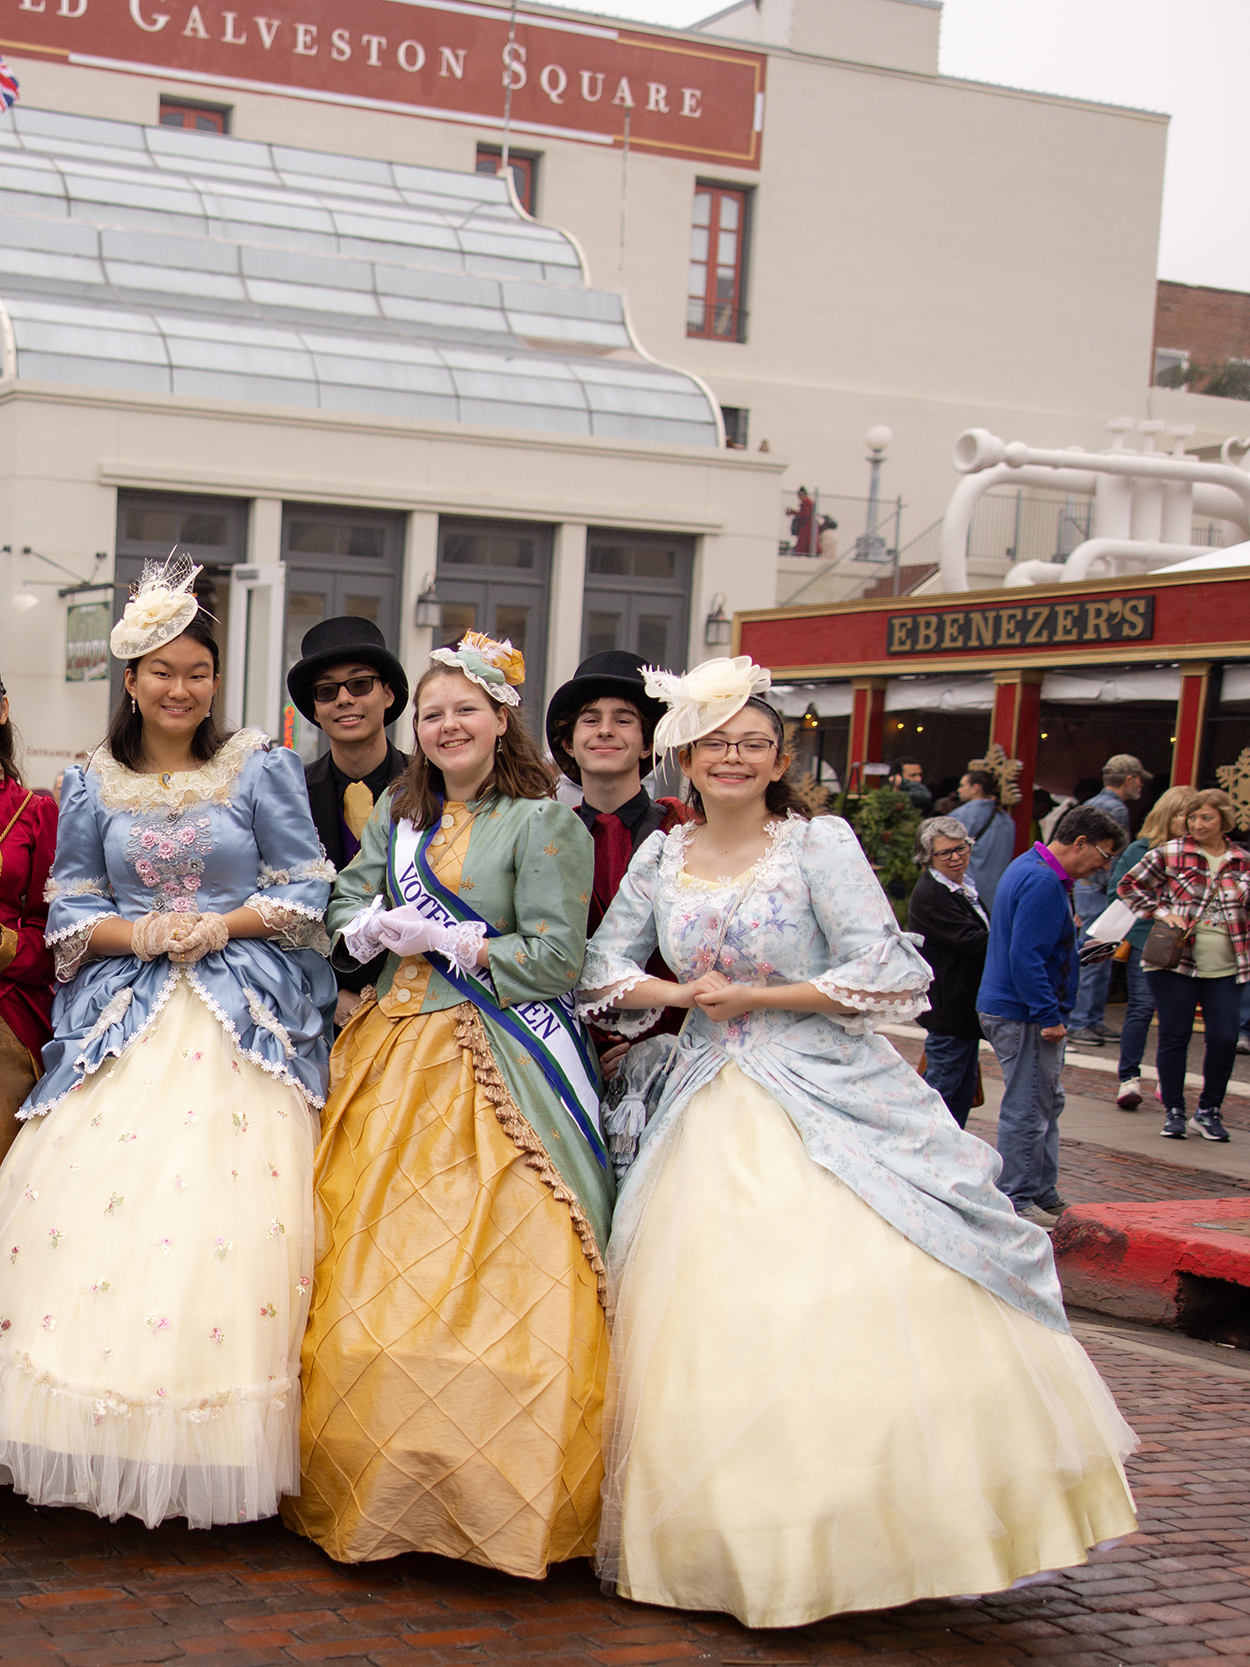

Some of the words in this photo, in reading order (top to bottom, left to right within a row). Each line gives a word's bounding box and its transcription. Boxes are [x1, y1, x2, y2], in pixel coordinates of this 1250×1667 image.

[128, 0, 468, 80] GALVESTON
[501, 41, 703, 118] SQUARE
[890, 598, 1147, 652] EBENEZER'S
